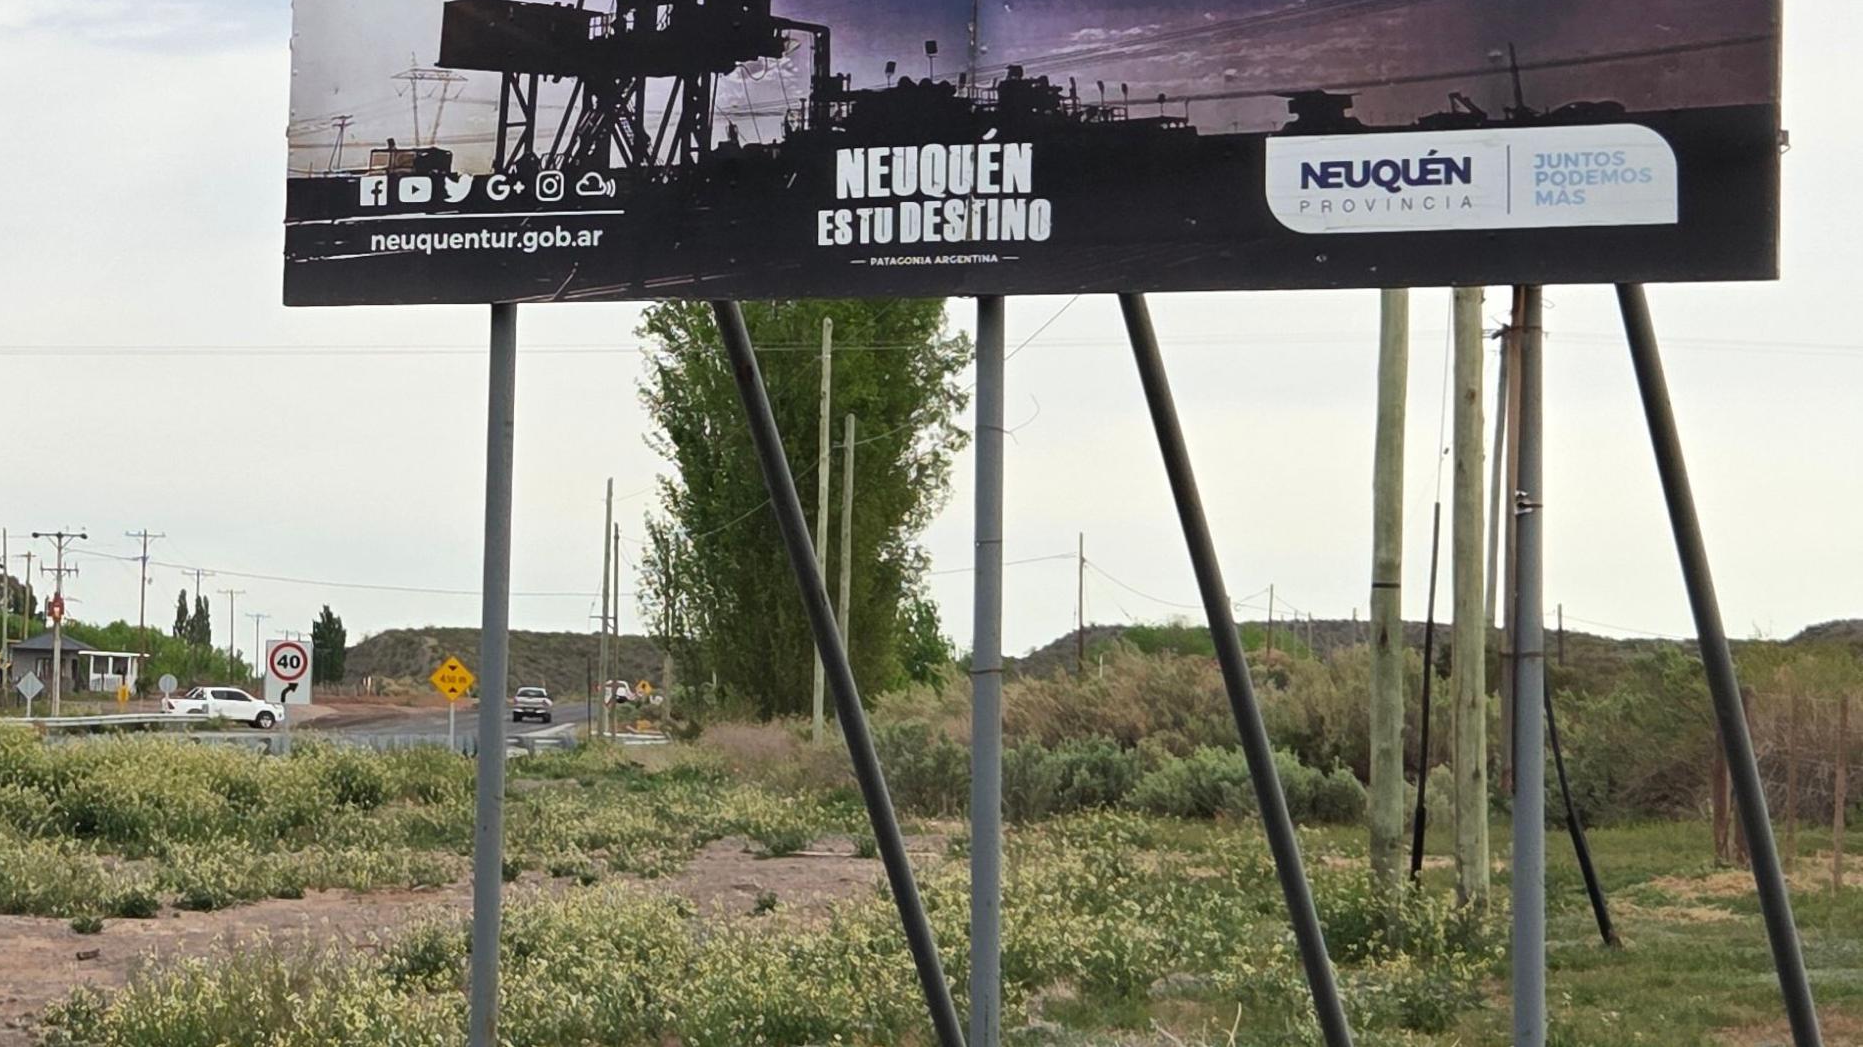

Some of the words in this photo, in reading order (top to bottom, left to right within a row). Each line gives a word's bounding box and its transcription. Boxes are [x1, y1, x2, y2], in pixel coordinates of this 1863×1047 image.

[836, 128, 1033, 199] NEUQUÉN
[1300, 149, 1472, 194] NEUQUÉN
[1533, 151, 1627, 170] JUNTOS
[1534, 167, 1653, 188] PODEMOS
[1299, 196, 1474, 214] PROVINCIA
[1534, 183, 1587, 207] MÁS
[899, 197, 1053, 244] DESTINO
[371, 225, 603, 254] neuquentur.gob.ar
[870, 257, 932, 266] PATAGONIA
[934, 254, 999, 265] ARGENTINA
[277, 654, 300, 669] 40
